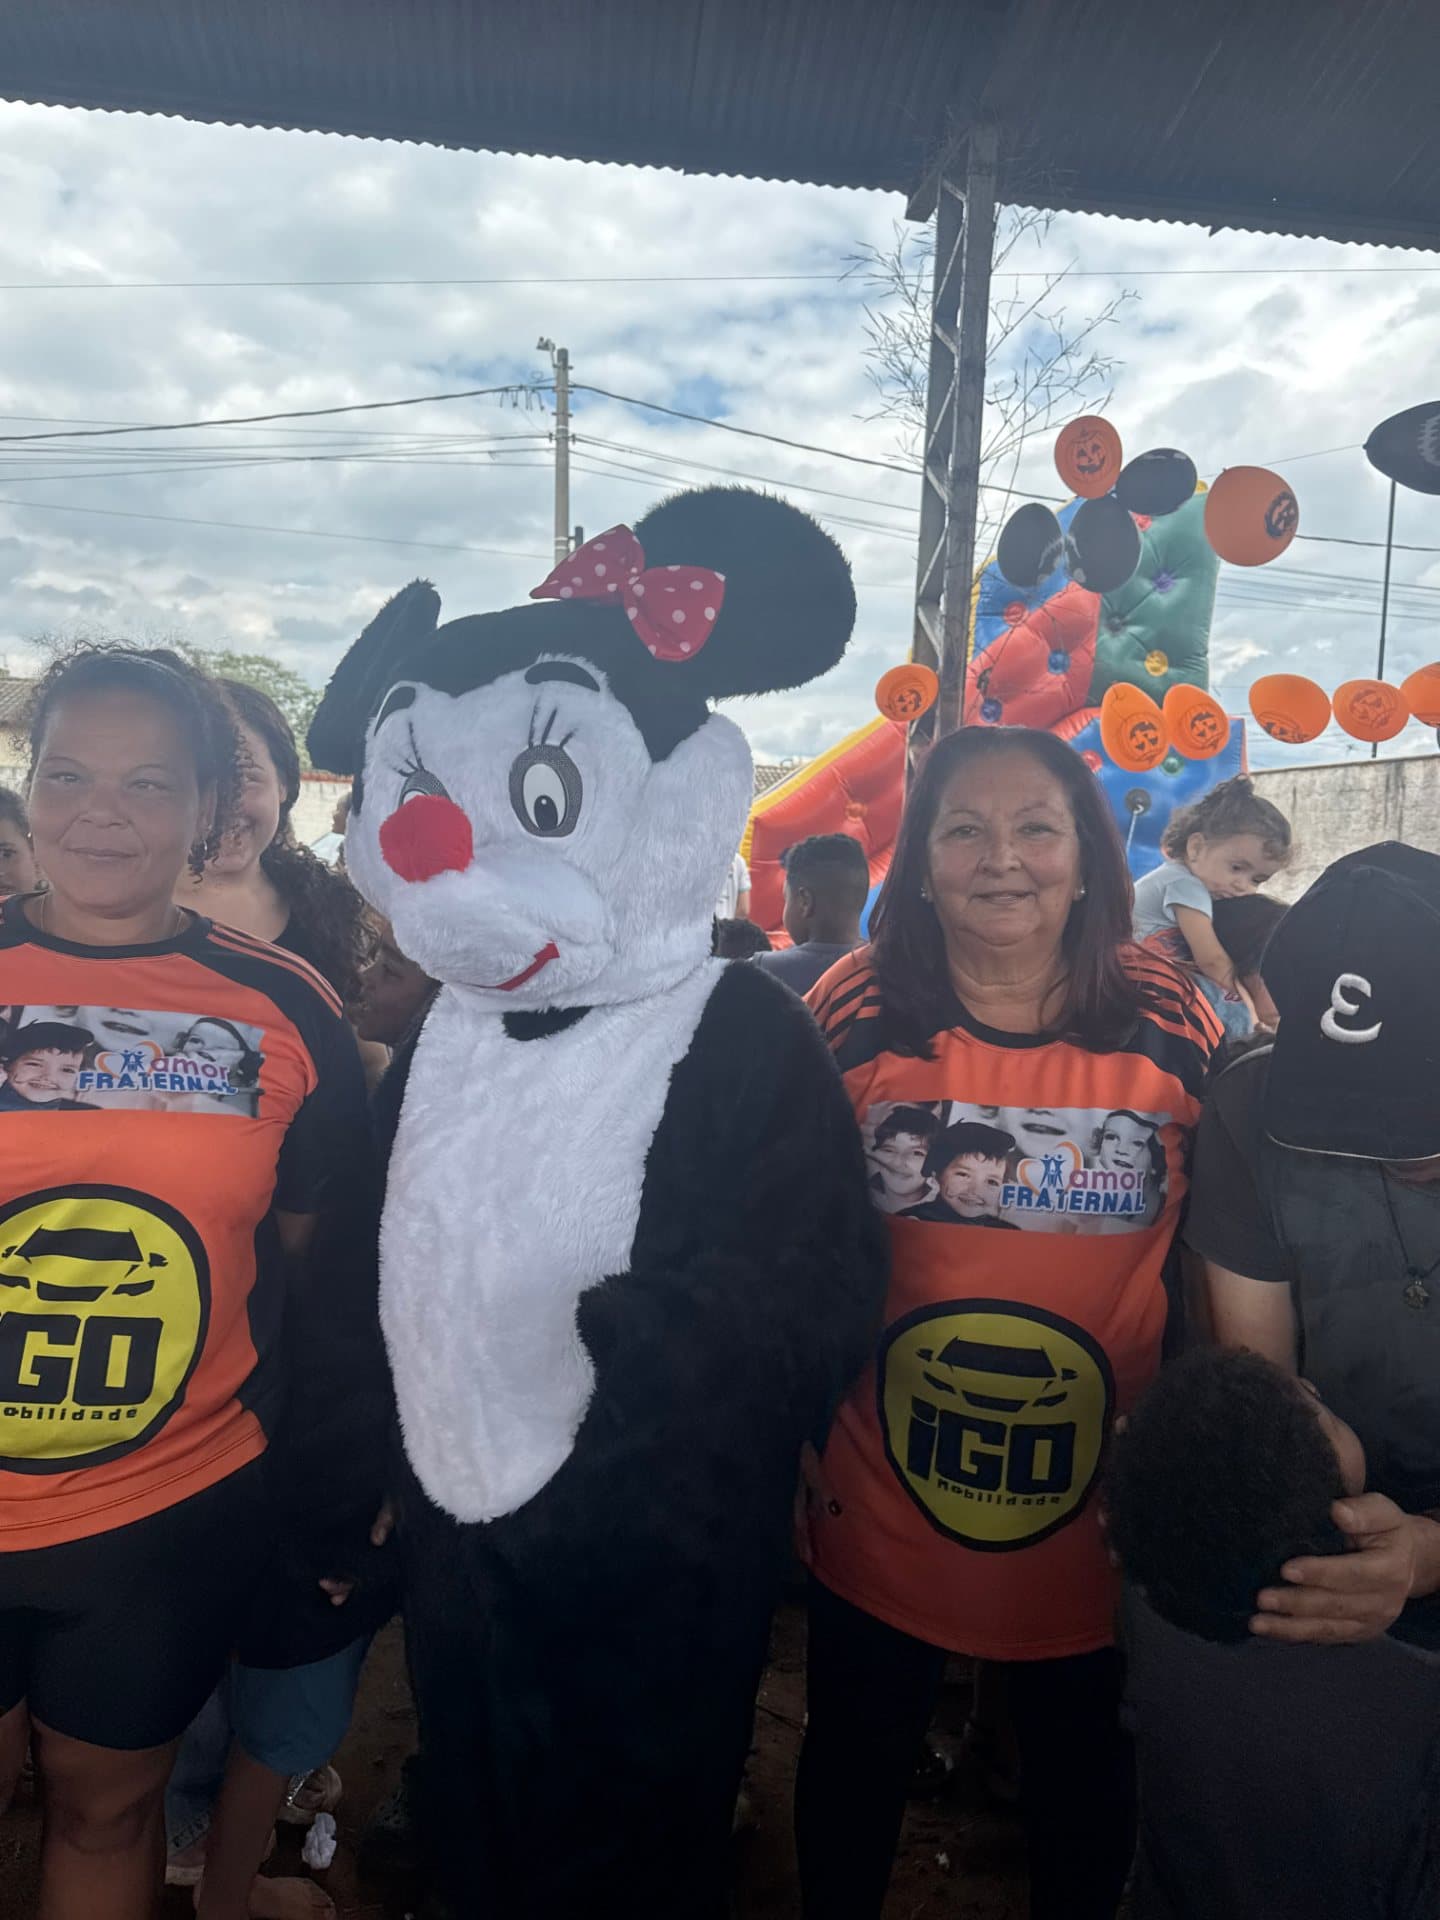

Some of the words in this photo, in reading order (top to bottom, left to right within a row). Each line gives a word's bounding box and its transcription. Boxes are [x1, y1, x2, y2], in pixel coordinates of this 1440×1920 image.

[150, 1058, 228, 1080] amor
[1070, 1170, 1144, 1190] amor
[1002, 1185, 1145, 1212] FRATERNAL
[0, 1311, 163, 1406] GO
[3, 1406, 137, 1421] obilidade
[907, 1395, 1076, 1495] iGO
